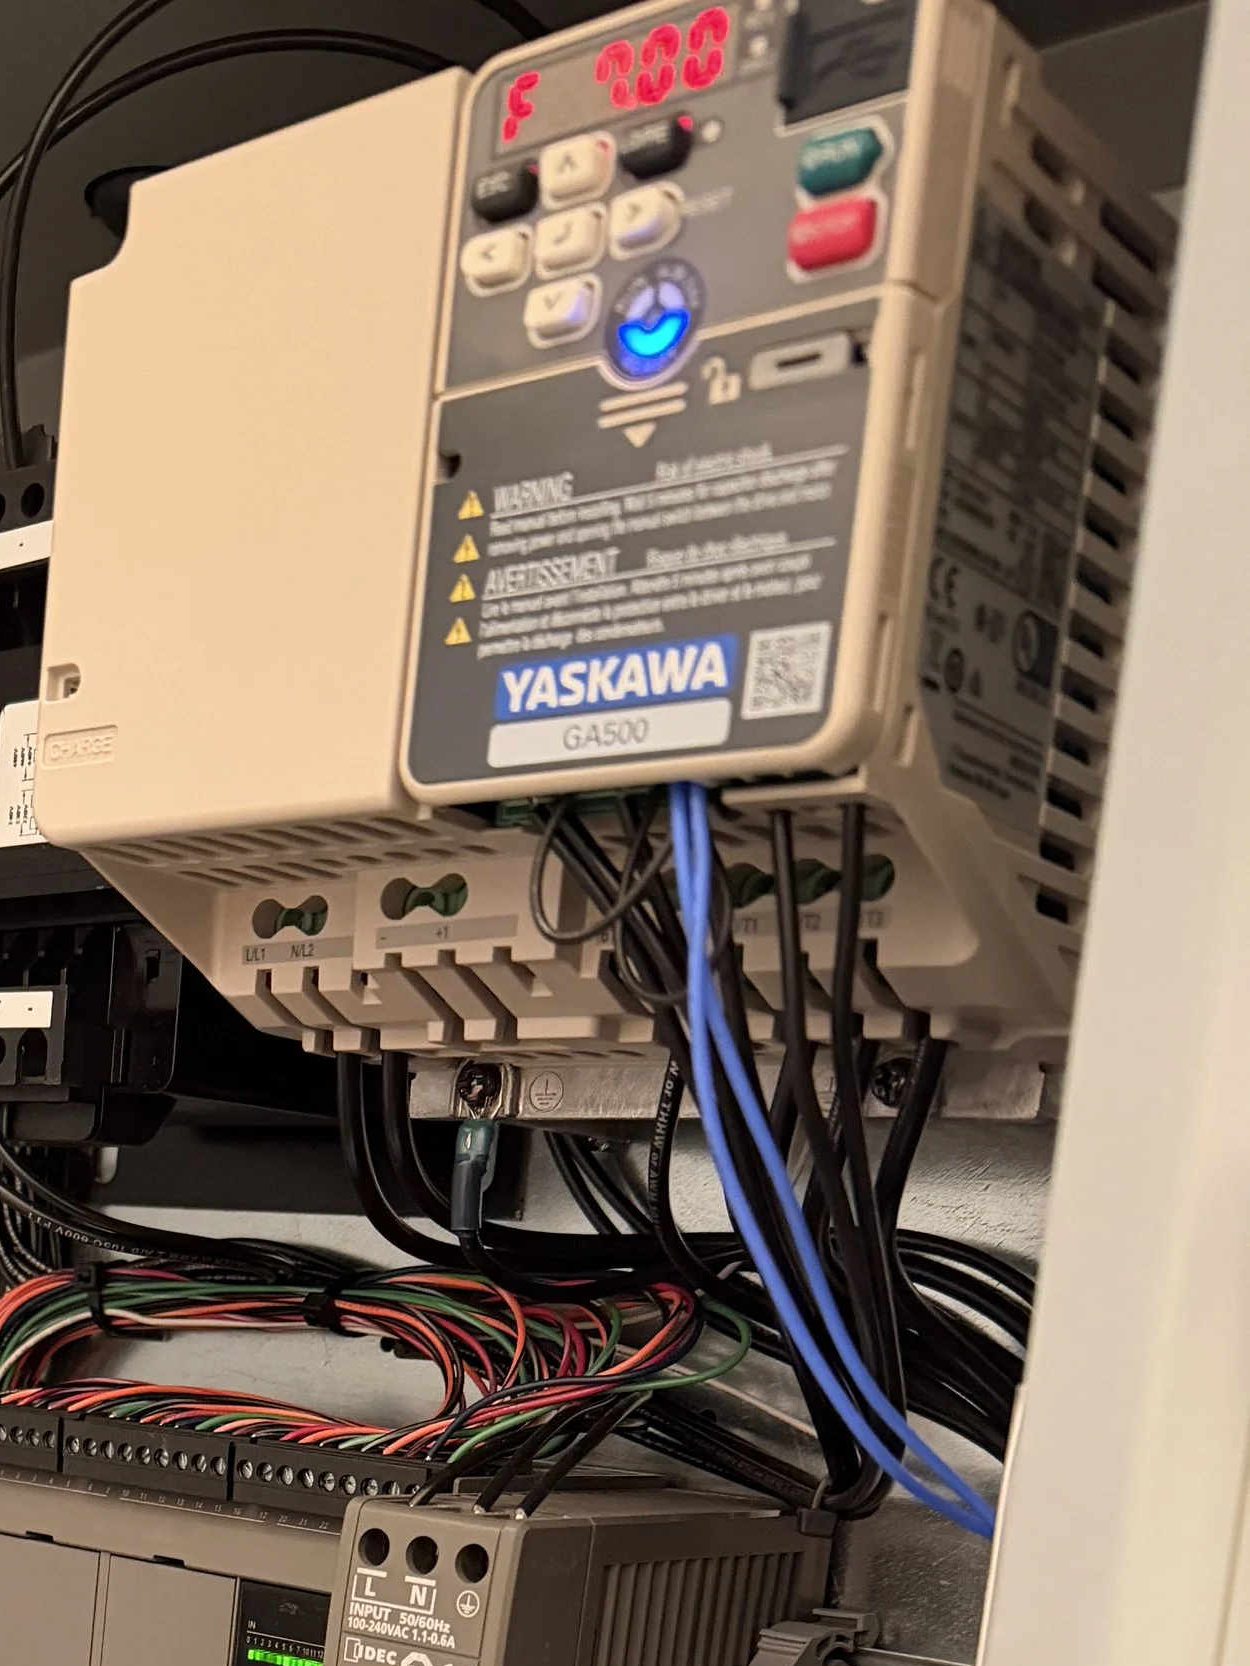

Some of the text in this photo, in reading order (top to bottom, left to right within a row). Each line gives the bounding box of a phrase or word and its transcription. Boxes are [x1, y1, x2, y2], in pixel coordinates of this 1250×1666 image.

[493, 471, 574, 514] WARNING
[485, 547, 620, 596] AVERTISSEMENT
[503, 642, 728, 714] YASKAWA
[562, 719, 649, 750] GA500
[245, 942, 314, 963] L/L1 N/L2
[364, 1576, 426, 1606] L N
[248, 1620, 256, 1629] IN
[348, 1616, 455, 1649] 100-240VAC 1.1-0.6A
[349, 1602, 450, 1633] INPUT 50/60Hz
[360, 1644, 397, 1665] IDEC
